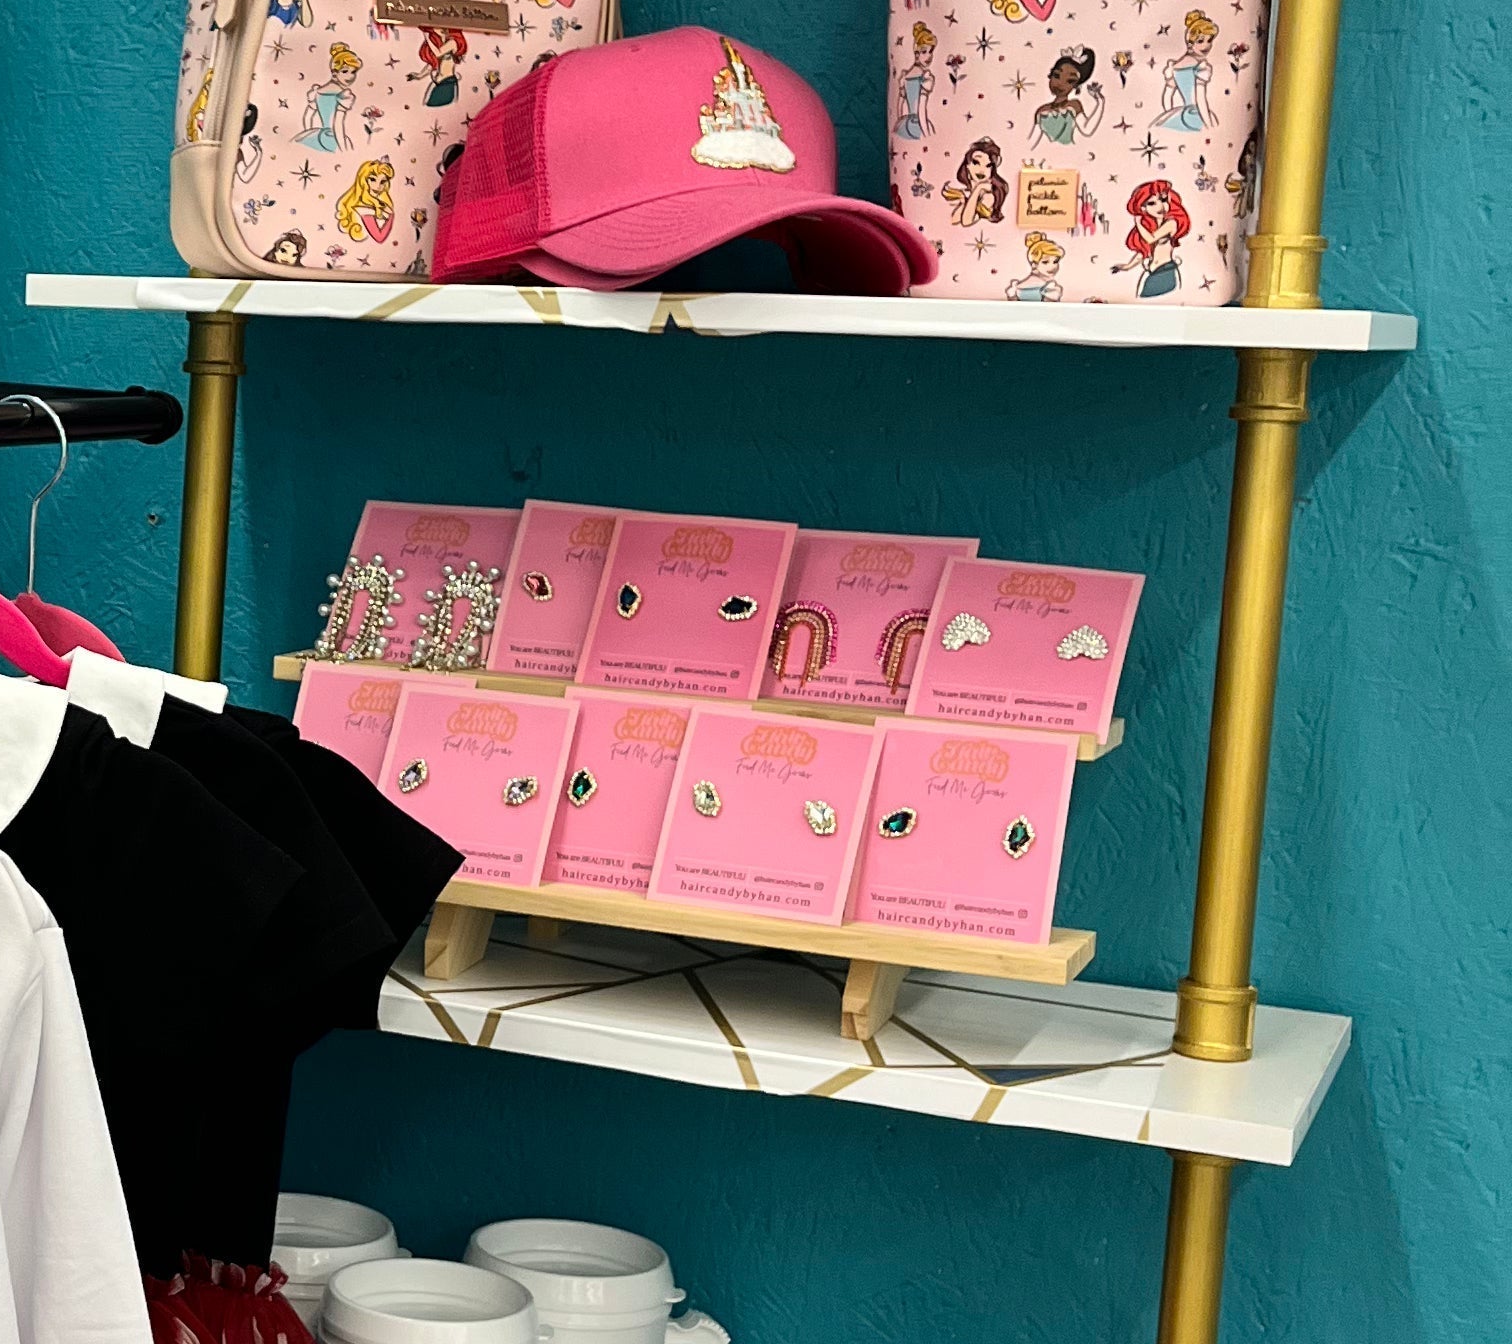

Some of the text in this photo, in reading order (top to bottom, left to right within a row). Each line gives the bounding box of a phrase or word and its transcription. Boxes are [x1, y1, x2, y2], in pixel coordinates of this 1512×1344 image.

[514, 659, 577, 674] haircandyb
[604, 673, 727, 694] haircandybyhan.com
[938, 704, 1075, 726] haircandybyhan.com
[561, 868, 650, 889] haircandybyha
[680, 880, 811, 907] haircandybyhan.com
[878, 909, 1016, 936] haircandybyhan.com
